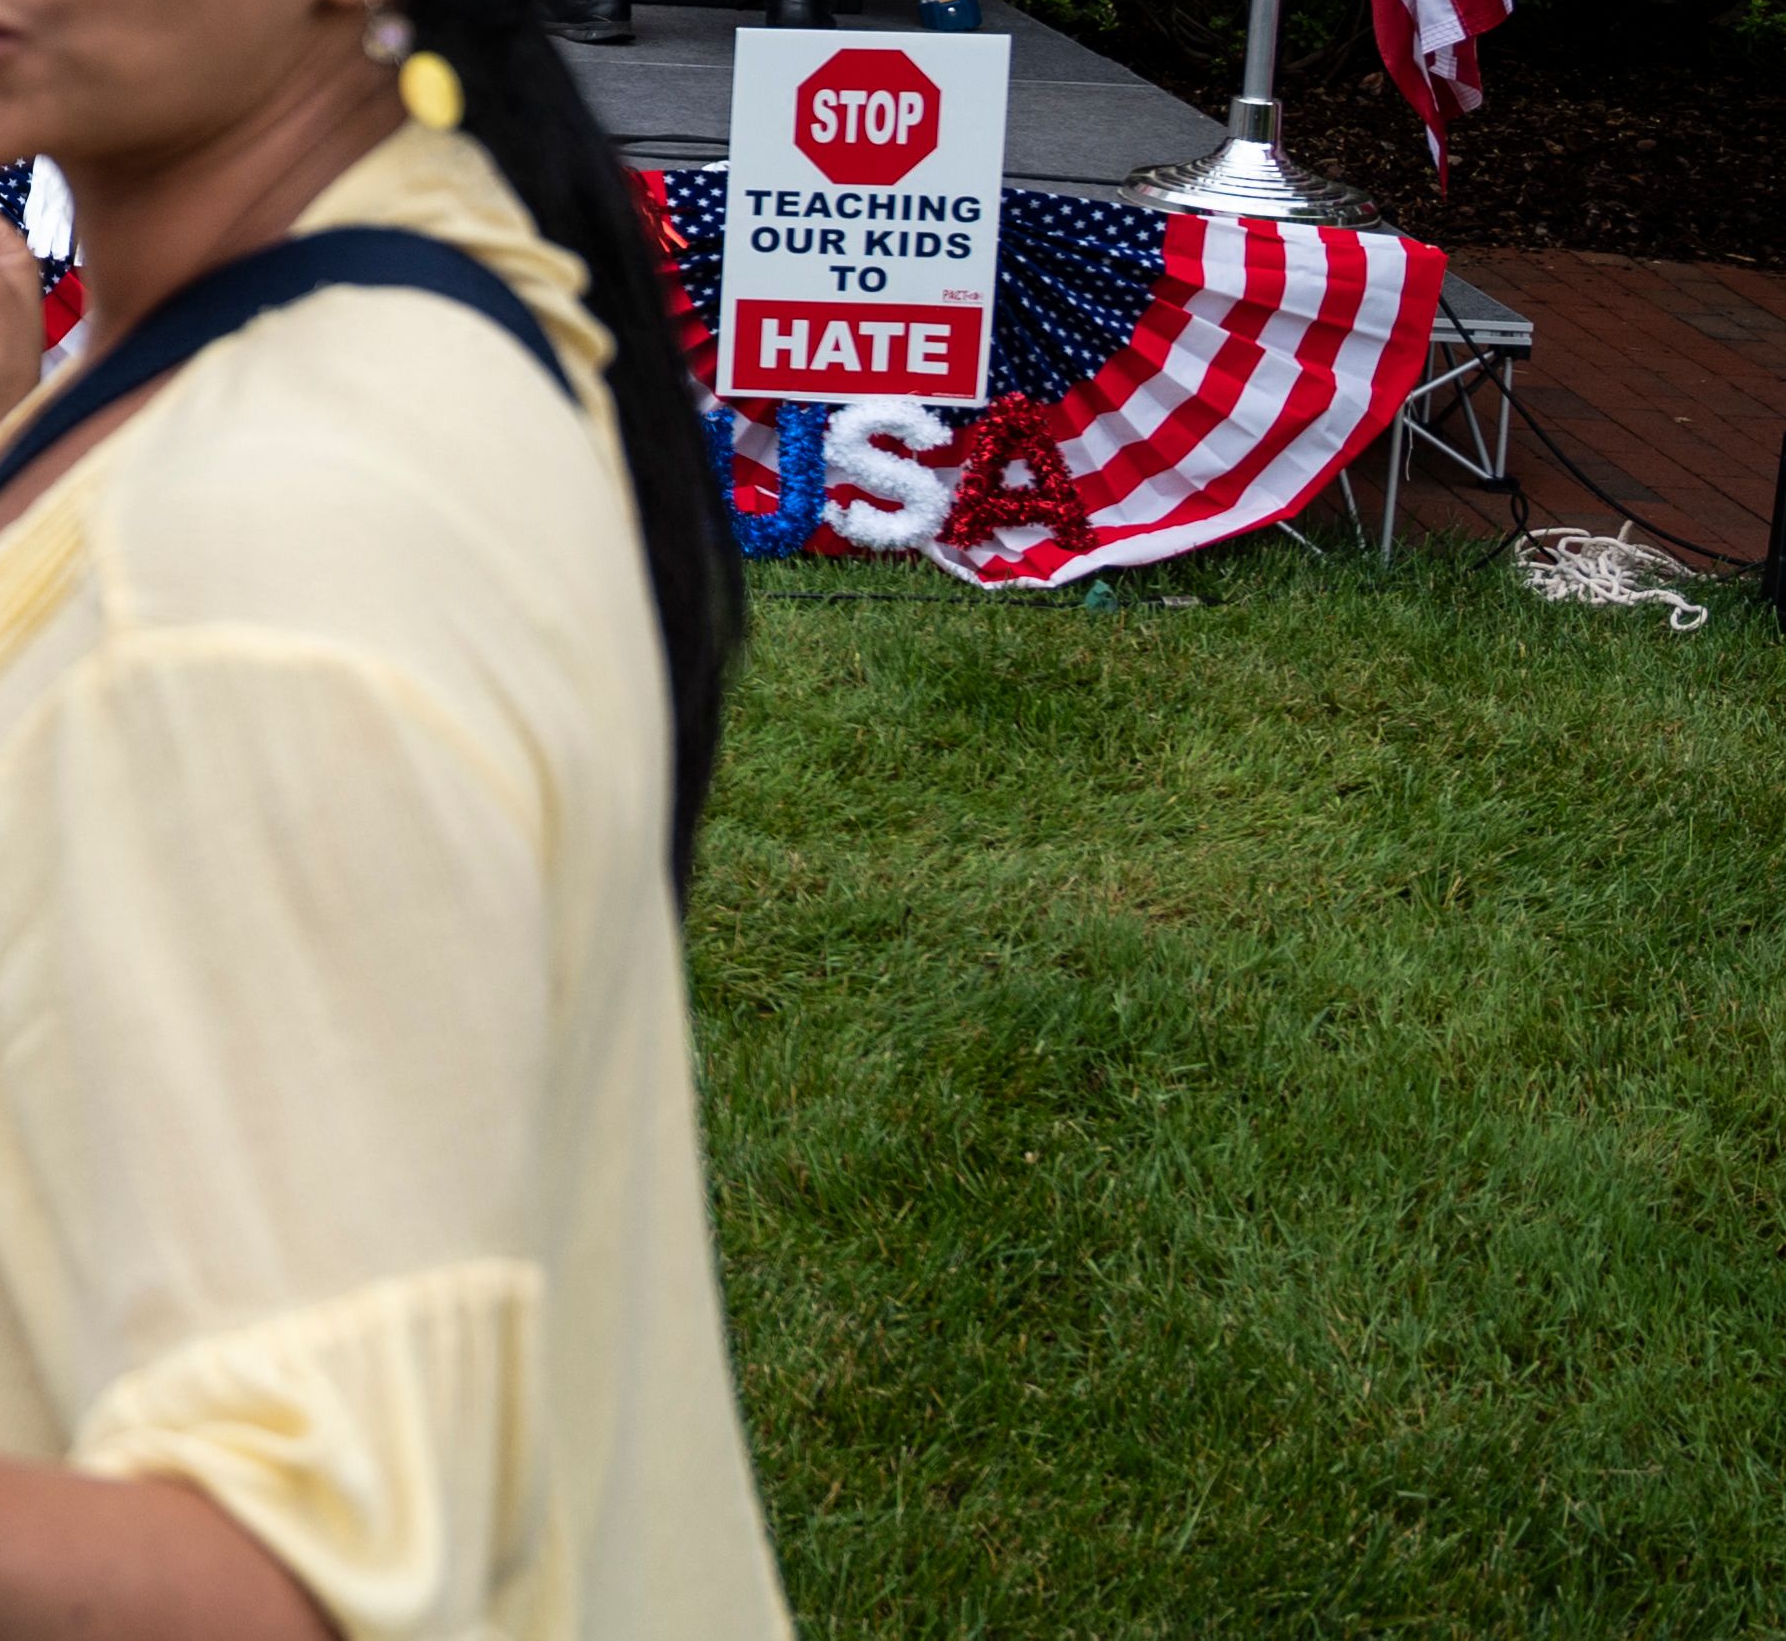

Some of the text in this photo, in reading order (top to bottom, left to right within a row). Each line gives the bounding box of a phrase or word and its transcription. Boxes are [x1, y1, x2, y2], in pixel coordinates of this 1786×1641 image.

[809, 88, 925, 146] STOP
[745, 189, 982, 224] TEACHING
[750, 226, 973, 260] OUR KIDS
[829, 264, 888, 294] TO
[759, 318, 952, 376] HATE
[700, 391, 1100, 559] USA
